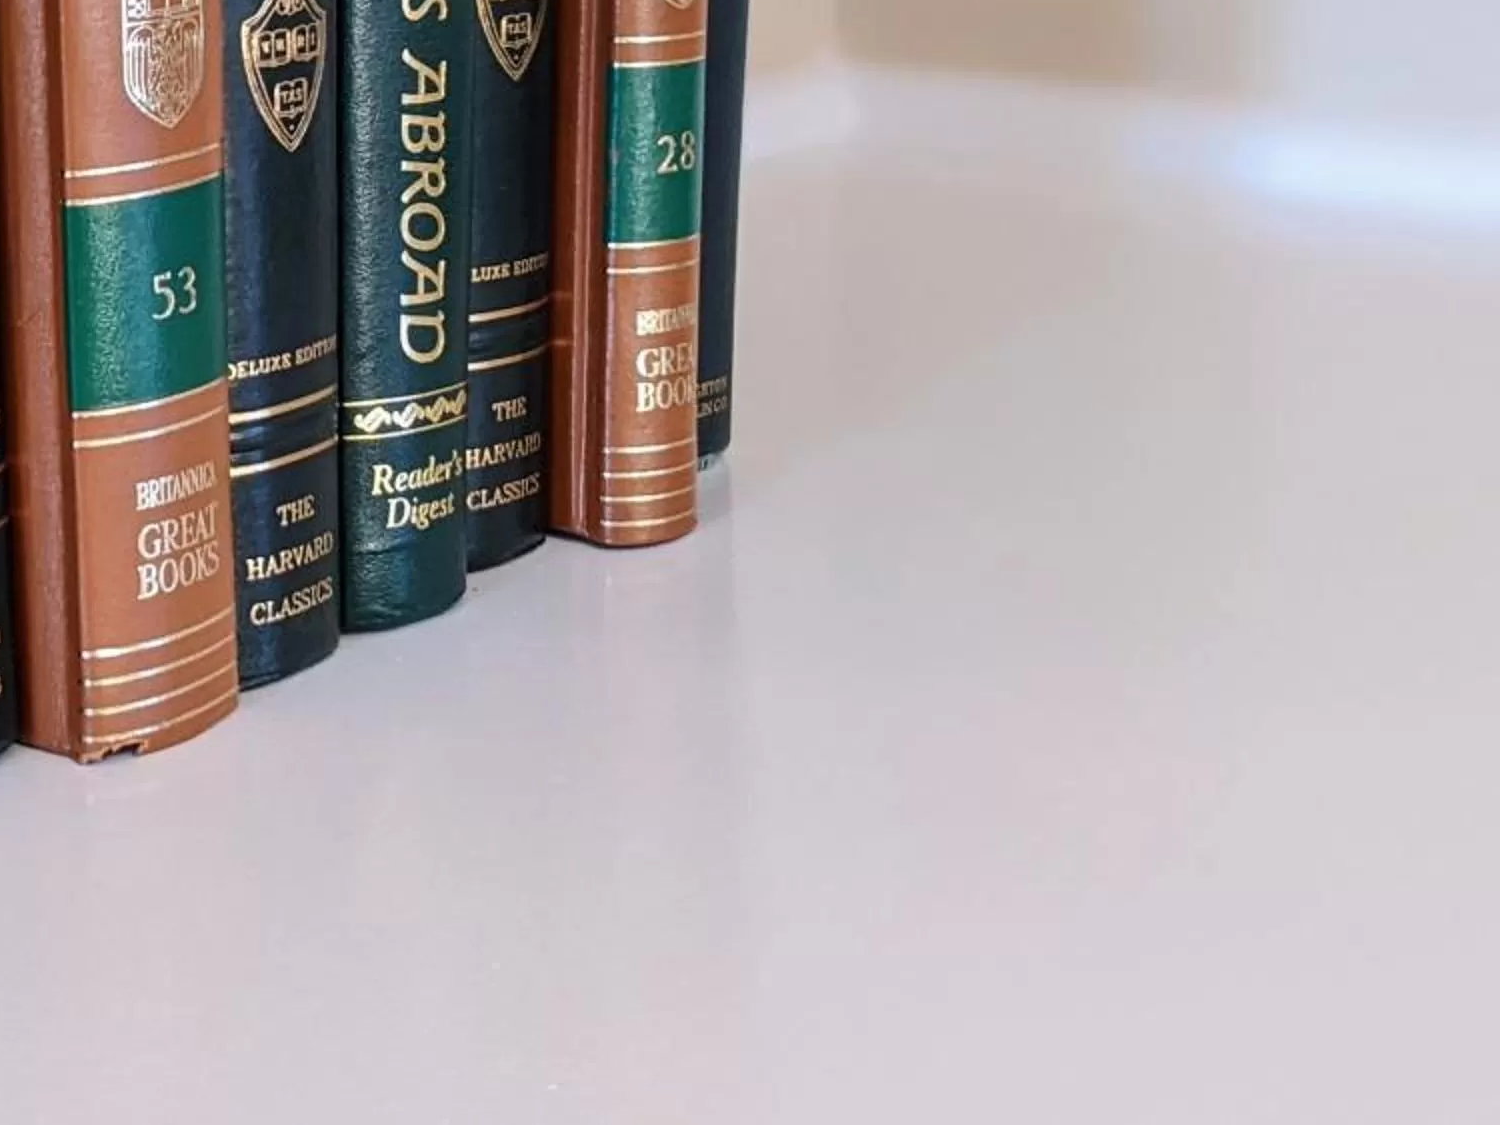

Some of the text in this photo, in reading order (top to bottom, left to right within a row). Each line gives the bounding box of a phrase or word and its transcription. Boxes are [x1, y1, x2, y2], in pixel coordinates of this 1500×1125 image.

[656, 130, 695, 174] 28
[399, 48, 448, 365] ABROAD
[152, 266, 198, 320] 53
[470, 263, 510, 283] LUXE
[635, 343, 695, 378] GRE
[491, 396, 527, 423] THE
[635, 375, 697, 412] BOOK
[464, 432, 541, 470] HARVARD
[372, 450, 464, 496] Reader's
[466, 472, 540, 511] CLASSICS
[137, 501, 220, 559] GREAT
[276, 494, 316, 527] THE
[386, 492, 455, 530] Digest
[137, 543, 220, 601] BOOKS
[245, 531, 334, 582] HARVARD
[250, 576, 333, 626] CLASSICS
